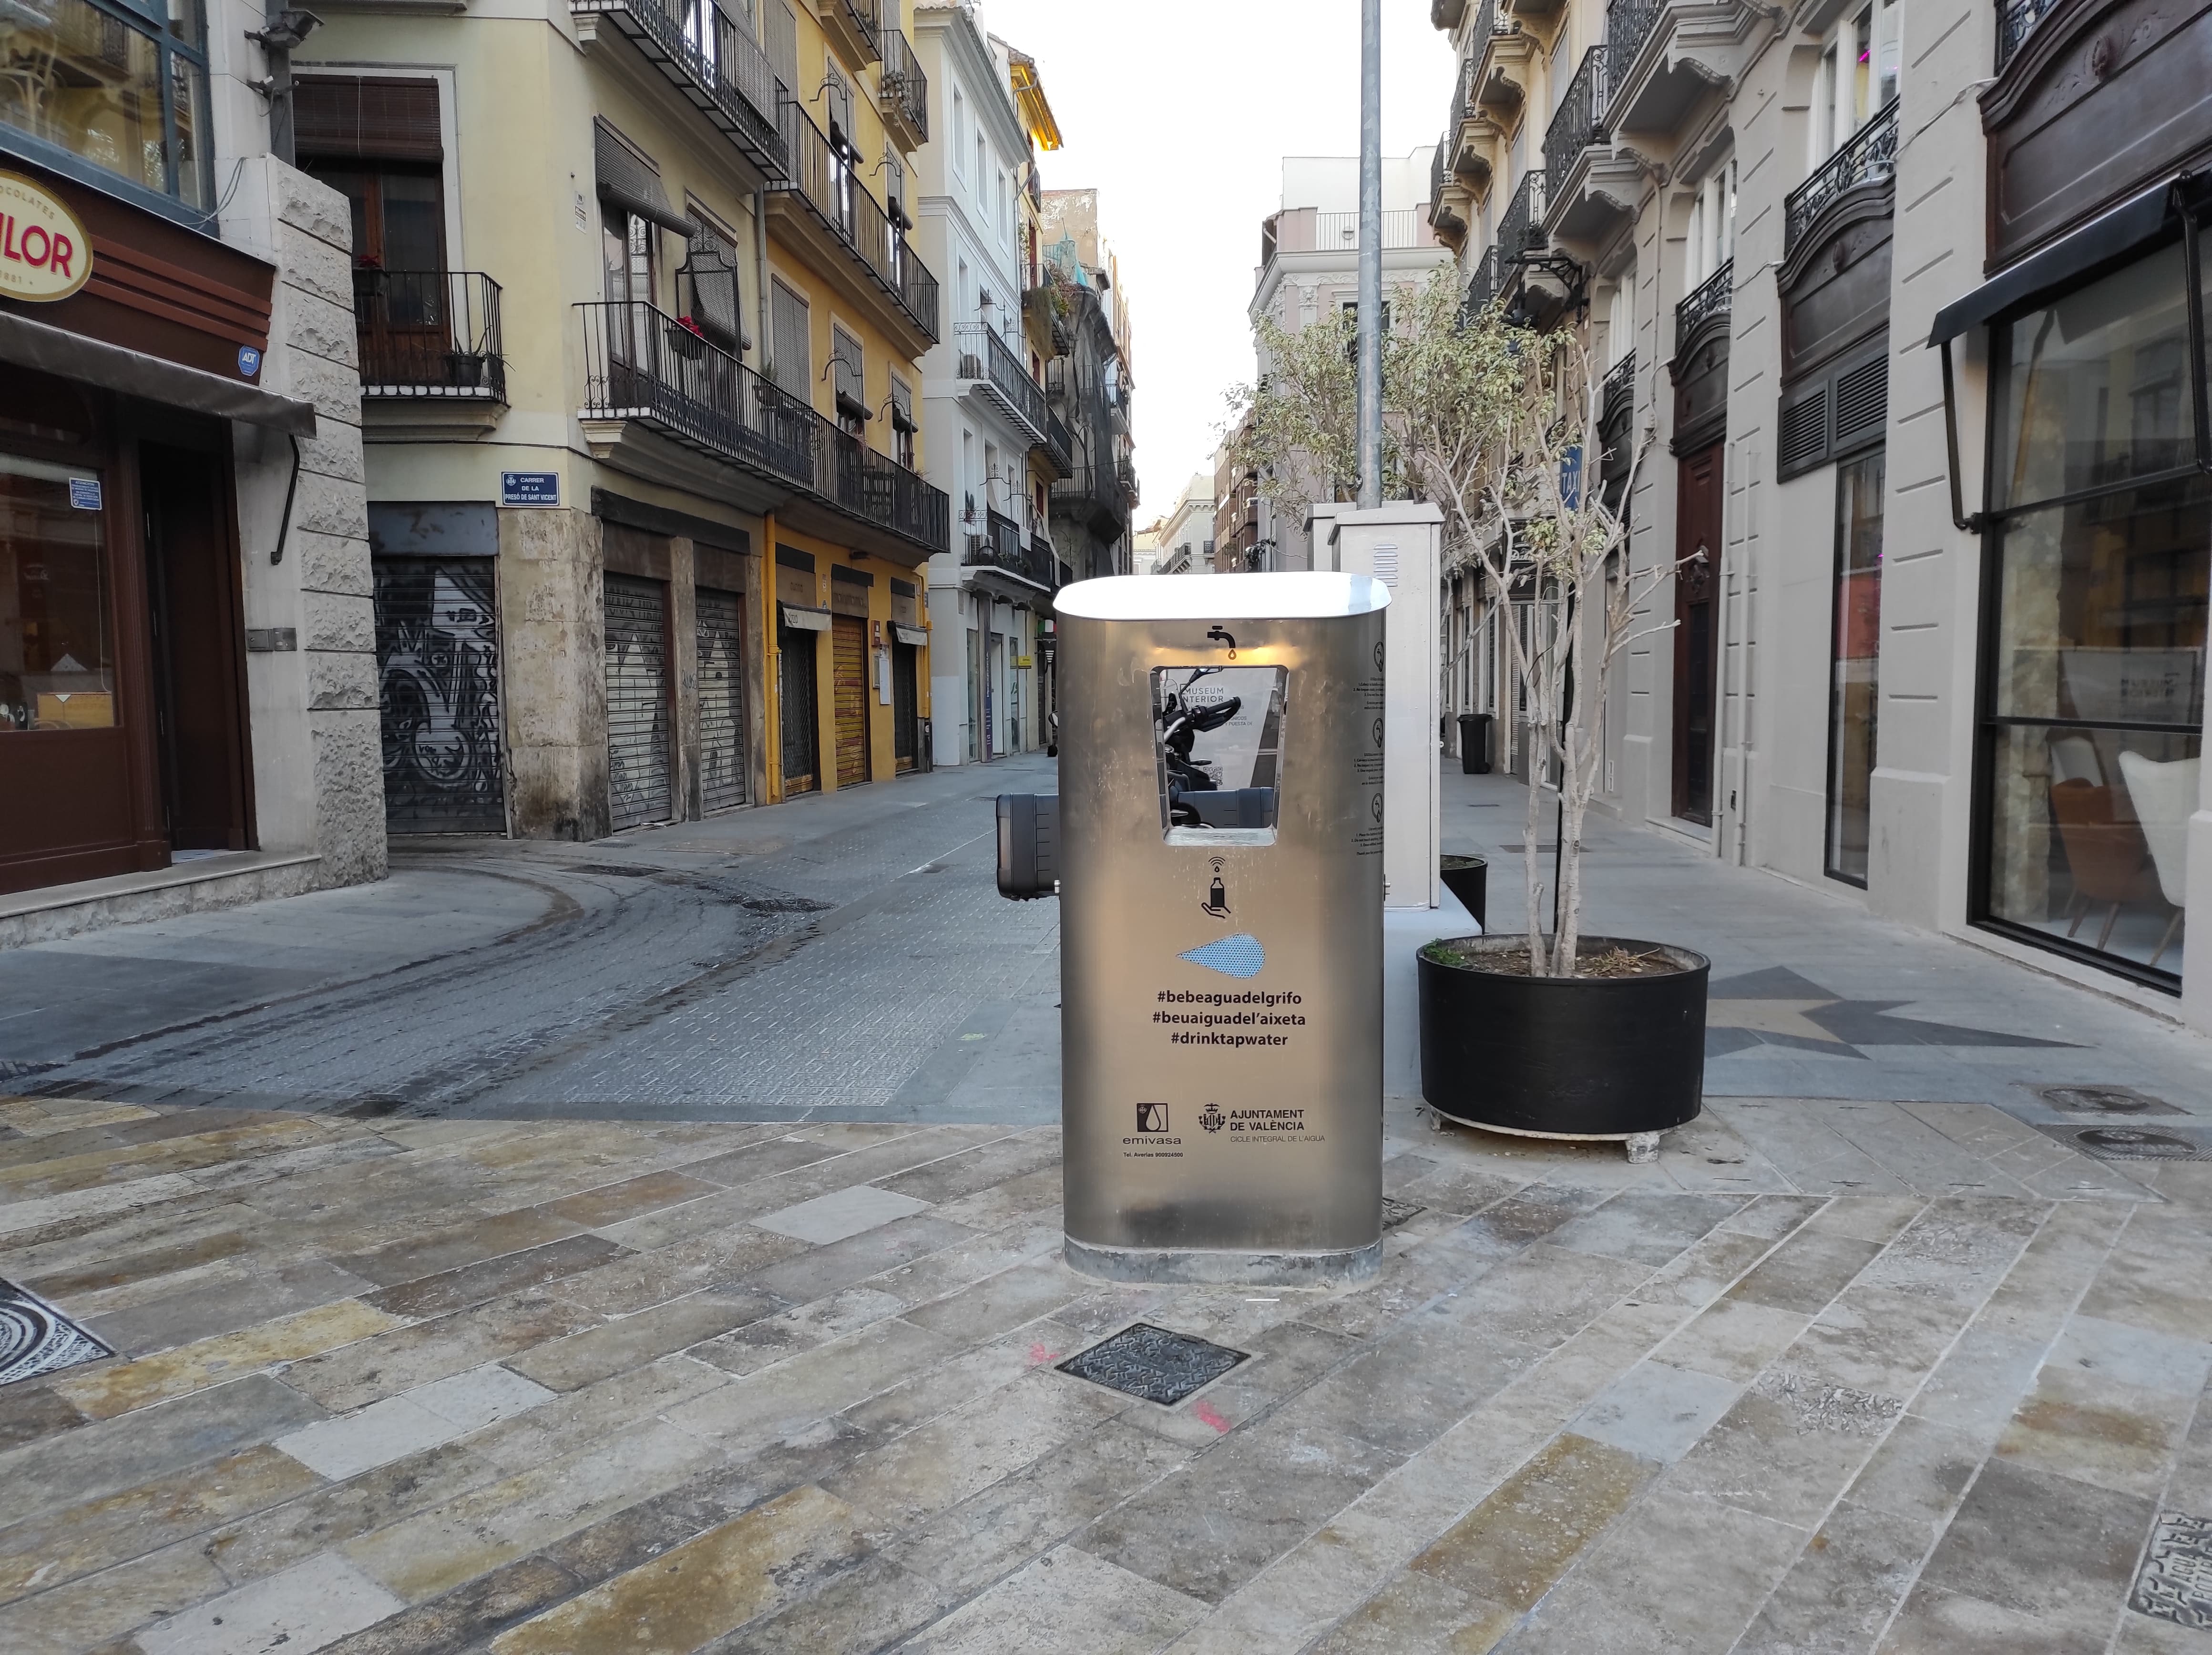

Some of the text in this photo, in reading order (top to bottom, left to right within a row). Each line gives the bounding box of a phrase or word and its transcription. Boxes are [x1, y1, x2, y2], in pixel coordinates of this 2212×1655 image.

[242, 352, 256, 364] ADT
[1562, 470, 1581, 493] TAXI
[1157, 990, 1302, 1007] #bebeaguadelgrifo
[1152, 1011, 1305, 1027] #beuaiguadel'aixeta
[1171, 1032, 1288, 1048] #drinktapwater
[1230, 1110, 1304, 1119] AJUNTAMENT
[1230, 1119, 1304, 1131] DE VALÈNCIA
